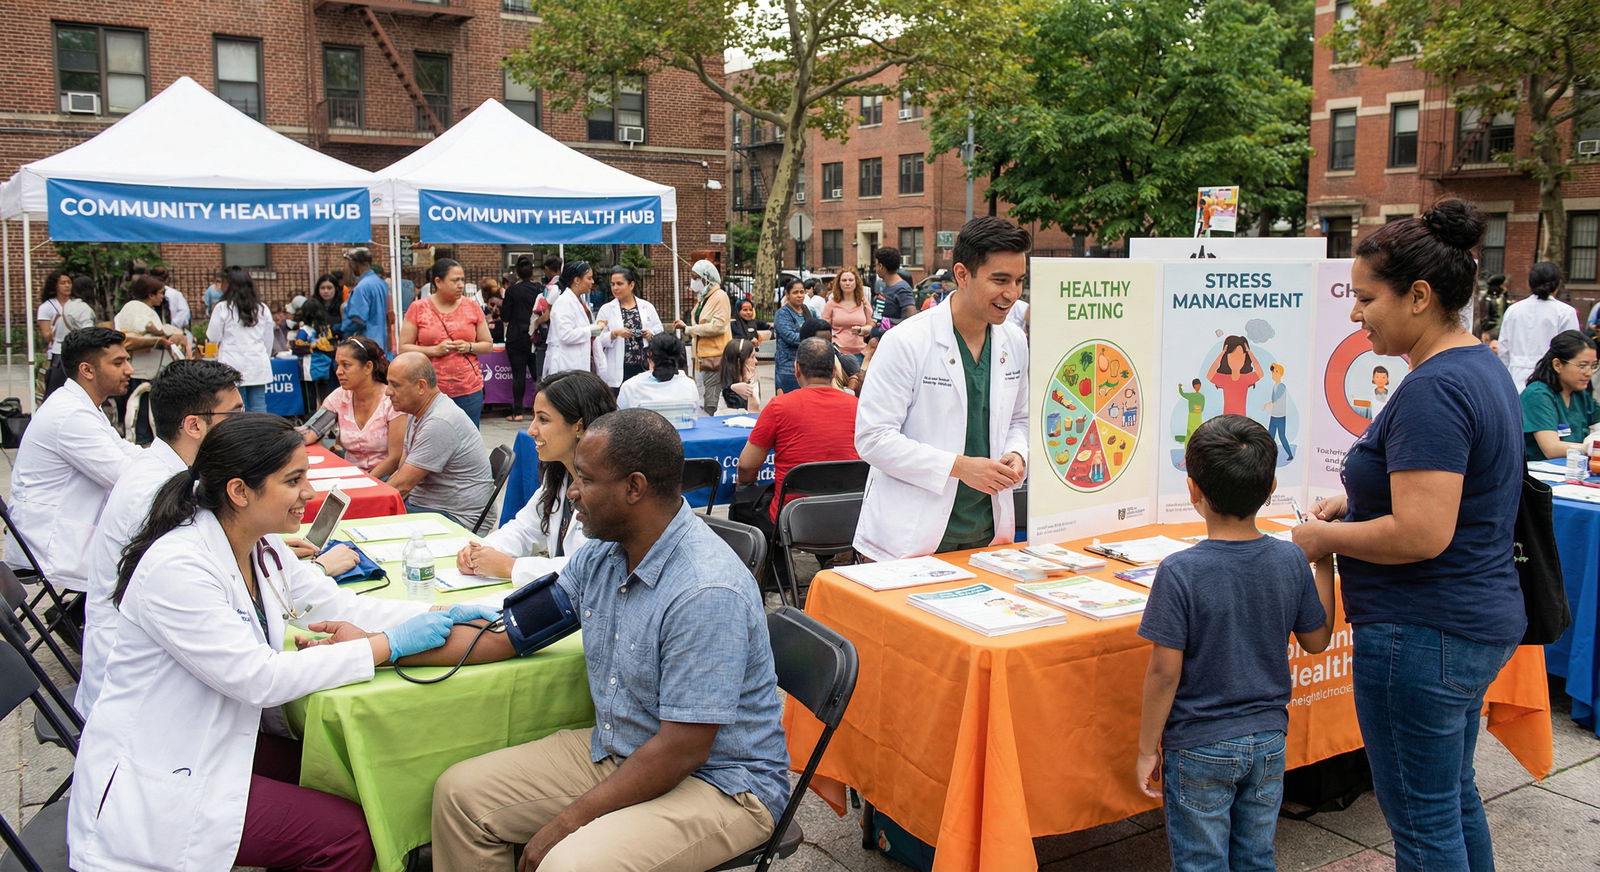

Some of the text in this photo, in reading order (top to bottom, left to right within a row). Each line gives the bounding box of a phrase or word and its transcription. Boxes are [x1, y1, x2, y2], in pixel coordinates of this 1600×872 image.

[59, 197, 361, 220] COMMUNITY HEALTH HUB
[428, 205, 655, 225] COMMUNITY HEALTH HUB
[1060, 280, 1131, 298] HEALTHY
[1205, 273, 1272, 289] STRESS
[1172, 292, 1304, 310] MANAGEMENT
[1067, 302, 1124, 321] EATING
[264, 382, 294, 393] HUB
